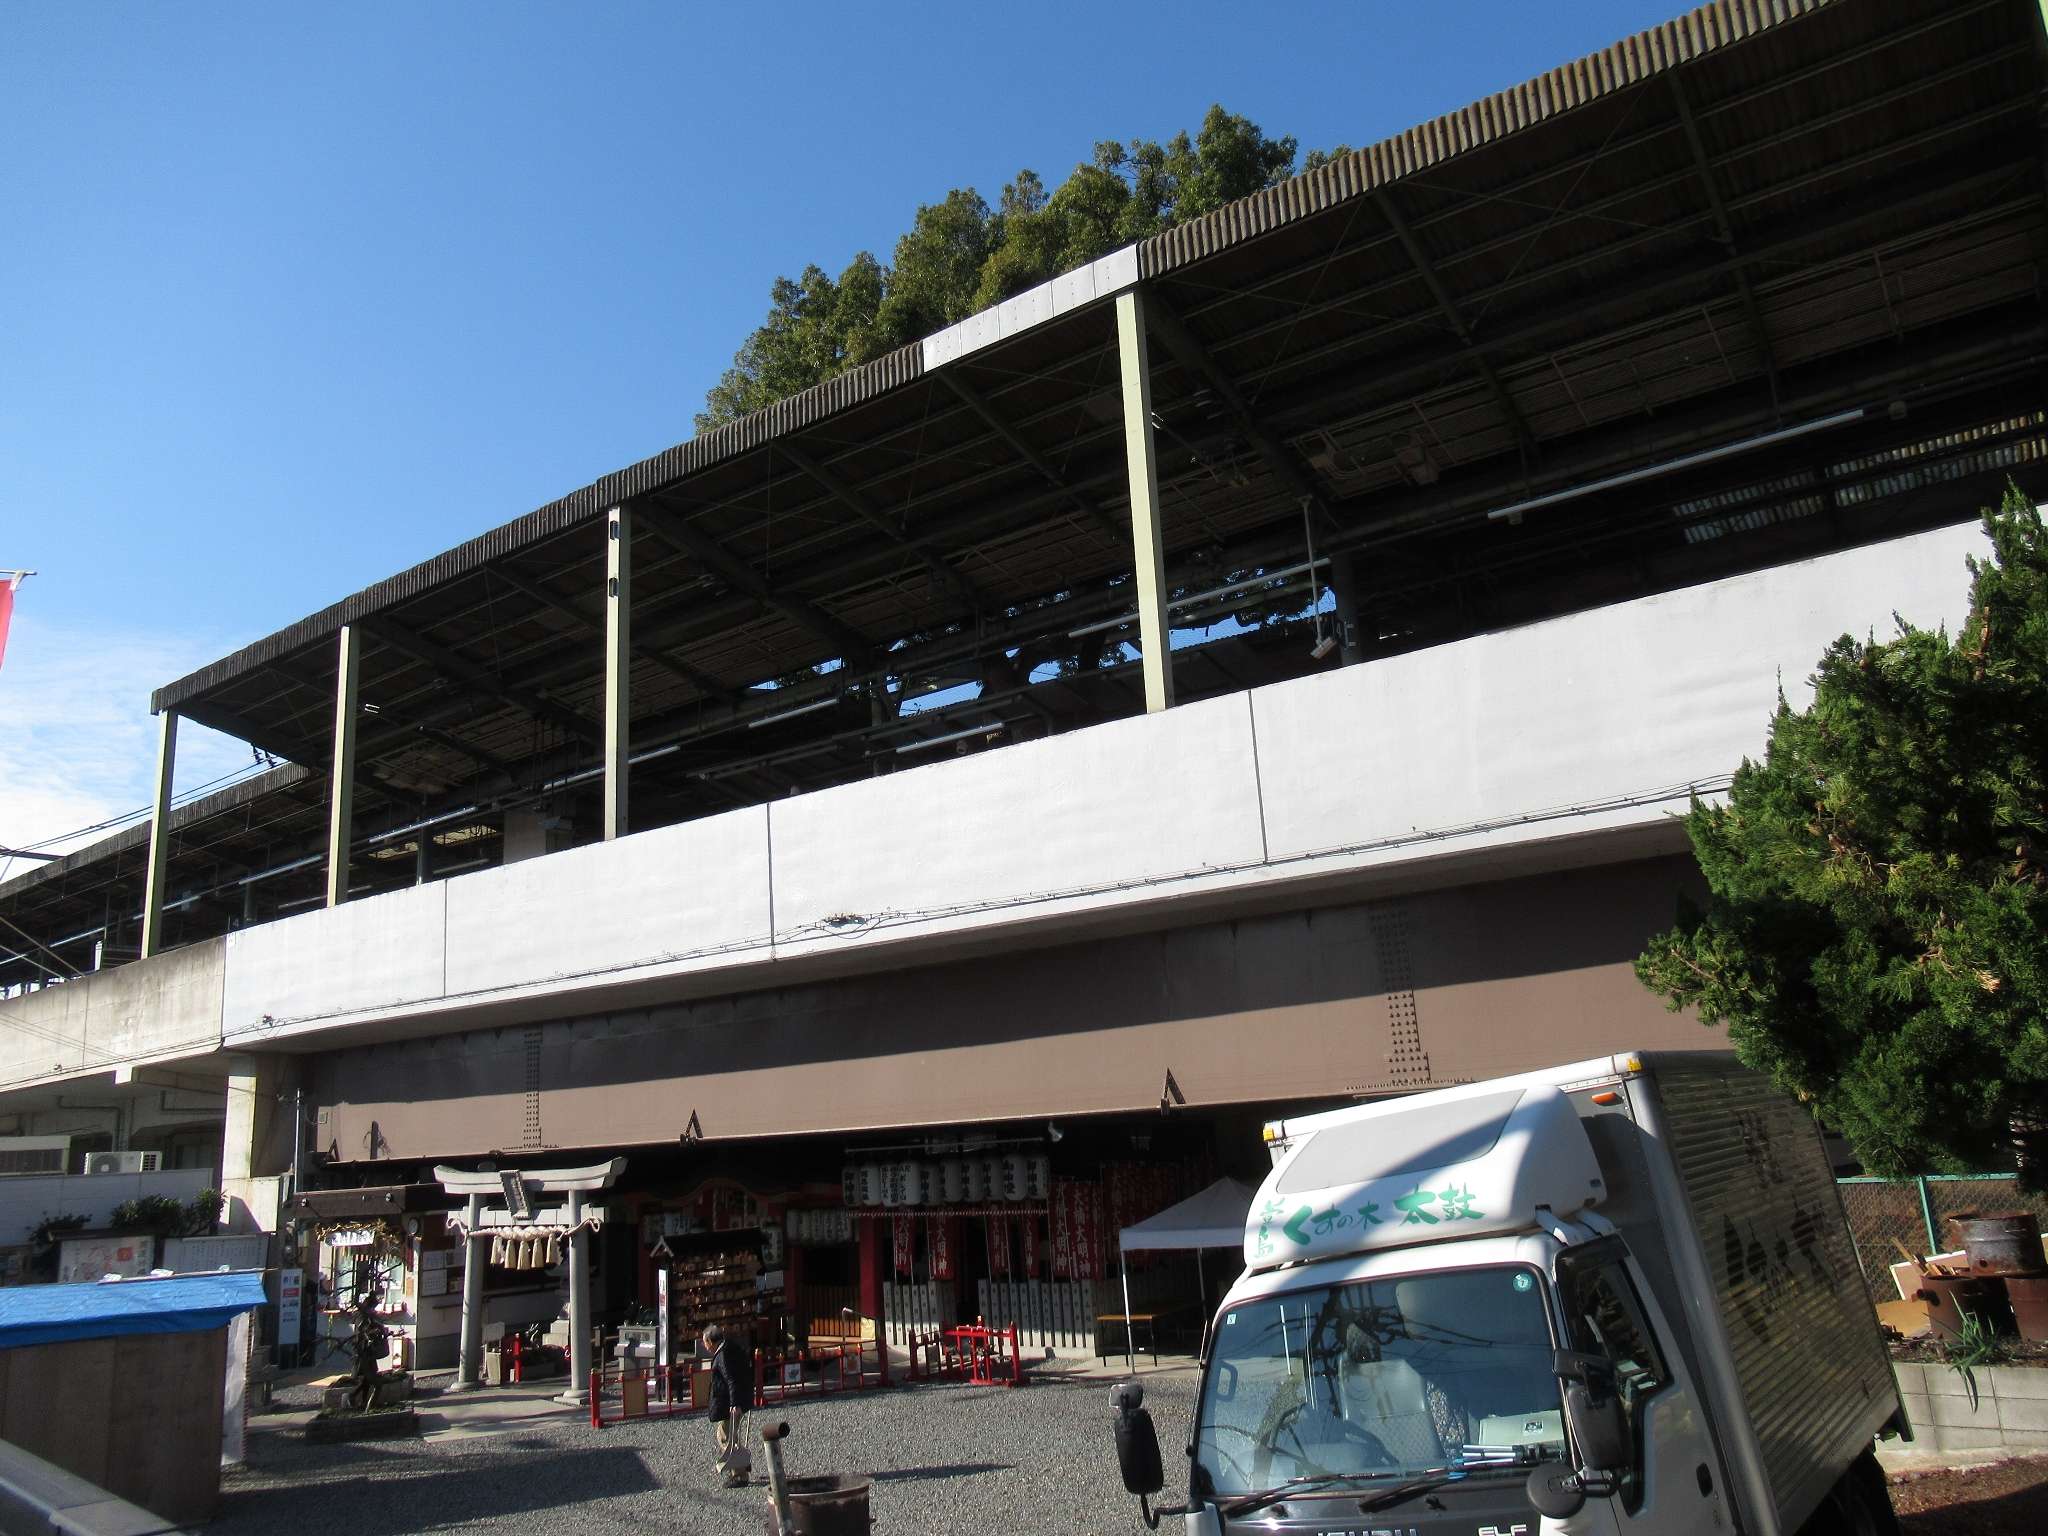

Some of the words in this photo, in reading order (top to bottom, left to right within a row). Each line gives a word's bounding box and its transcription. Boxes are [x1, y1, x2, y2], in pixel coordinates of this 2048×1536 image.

[1282, 1201, 1382, 1246] くすの木
[1393, 1182, 1486, 1226] 太鼓
